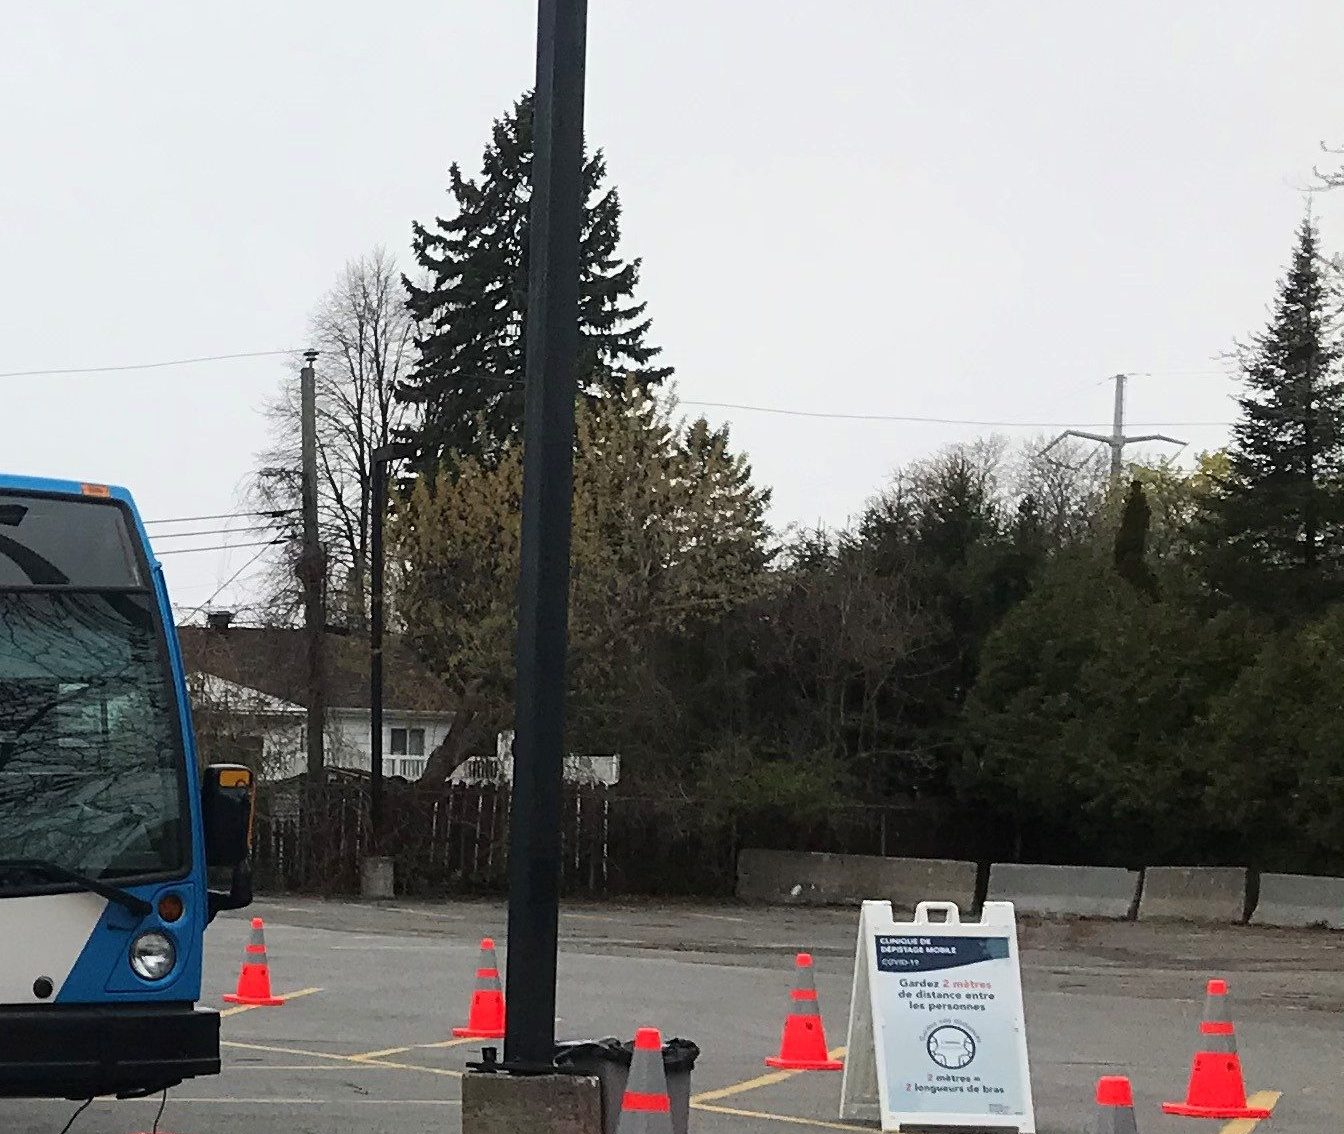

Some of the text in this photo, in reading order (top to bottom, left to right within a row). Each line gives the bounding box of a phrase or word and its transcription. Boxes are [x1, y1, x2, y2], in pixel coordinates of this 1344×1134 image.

[899, 979, 992, 989] Gardez 2 mètres
[898, 990, 995, 1000] de distance entre
[928, 1002, 985, 1012] personnes
